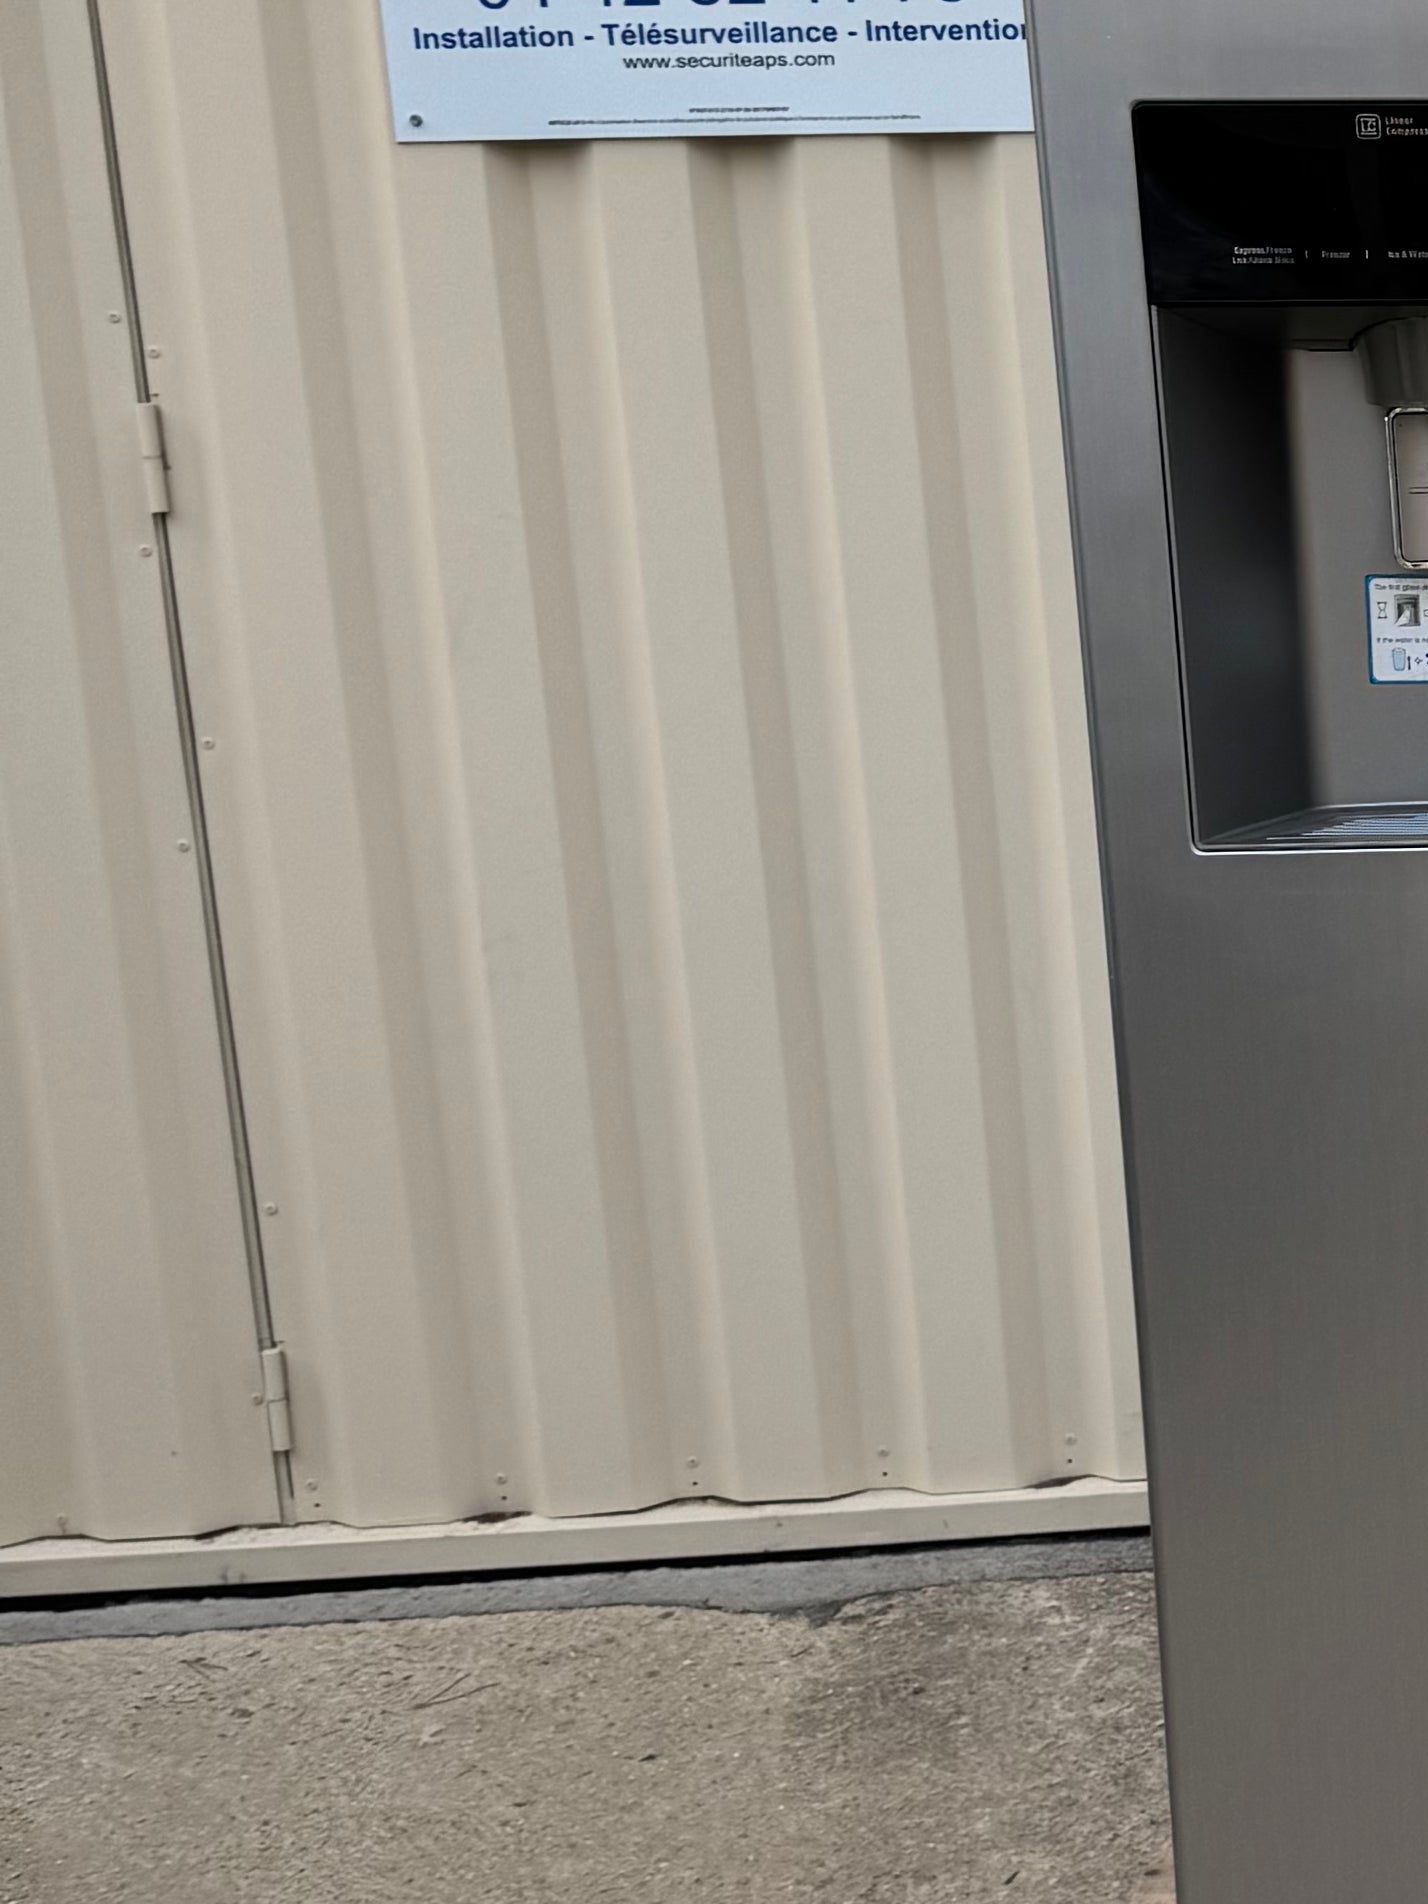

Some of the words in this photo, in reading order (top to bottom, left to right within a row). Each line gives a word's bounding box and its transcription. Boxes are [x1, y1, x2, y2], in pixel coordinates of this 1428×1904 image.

[413, 25, 574, 49] Installation
[601, 21, 837, 46] Télésurveillance
[623, 53, 835, 69] www.securiteaps.com
